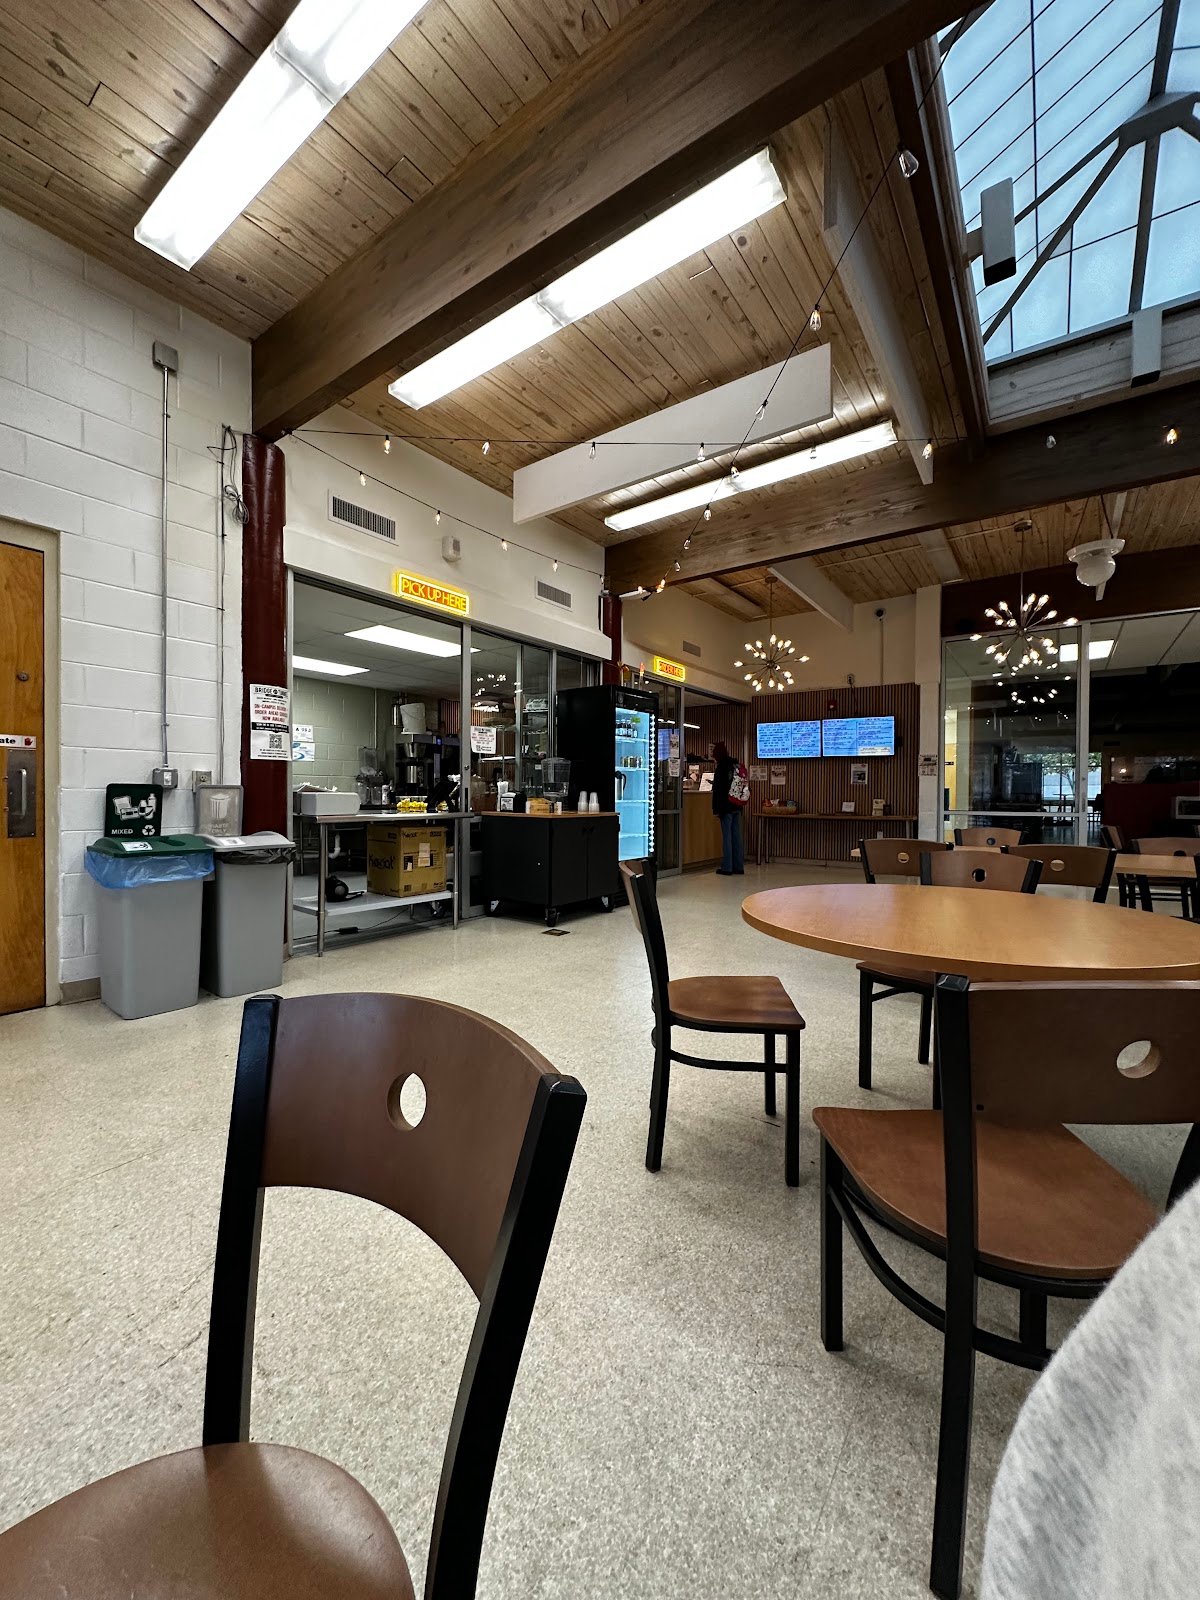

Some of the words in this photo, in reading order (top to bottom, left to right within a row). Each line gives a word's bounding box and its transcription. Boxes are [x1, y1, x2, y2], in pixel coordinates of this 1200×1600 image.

[402, 578, 425, 598] PICK
[427, 586, 441, 602] UP
[442, 591, 467, 610] HERE
